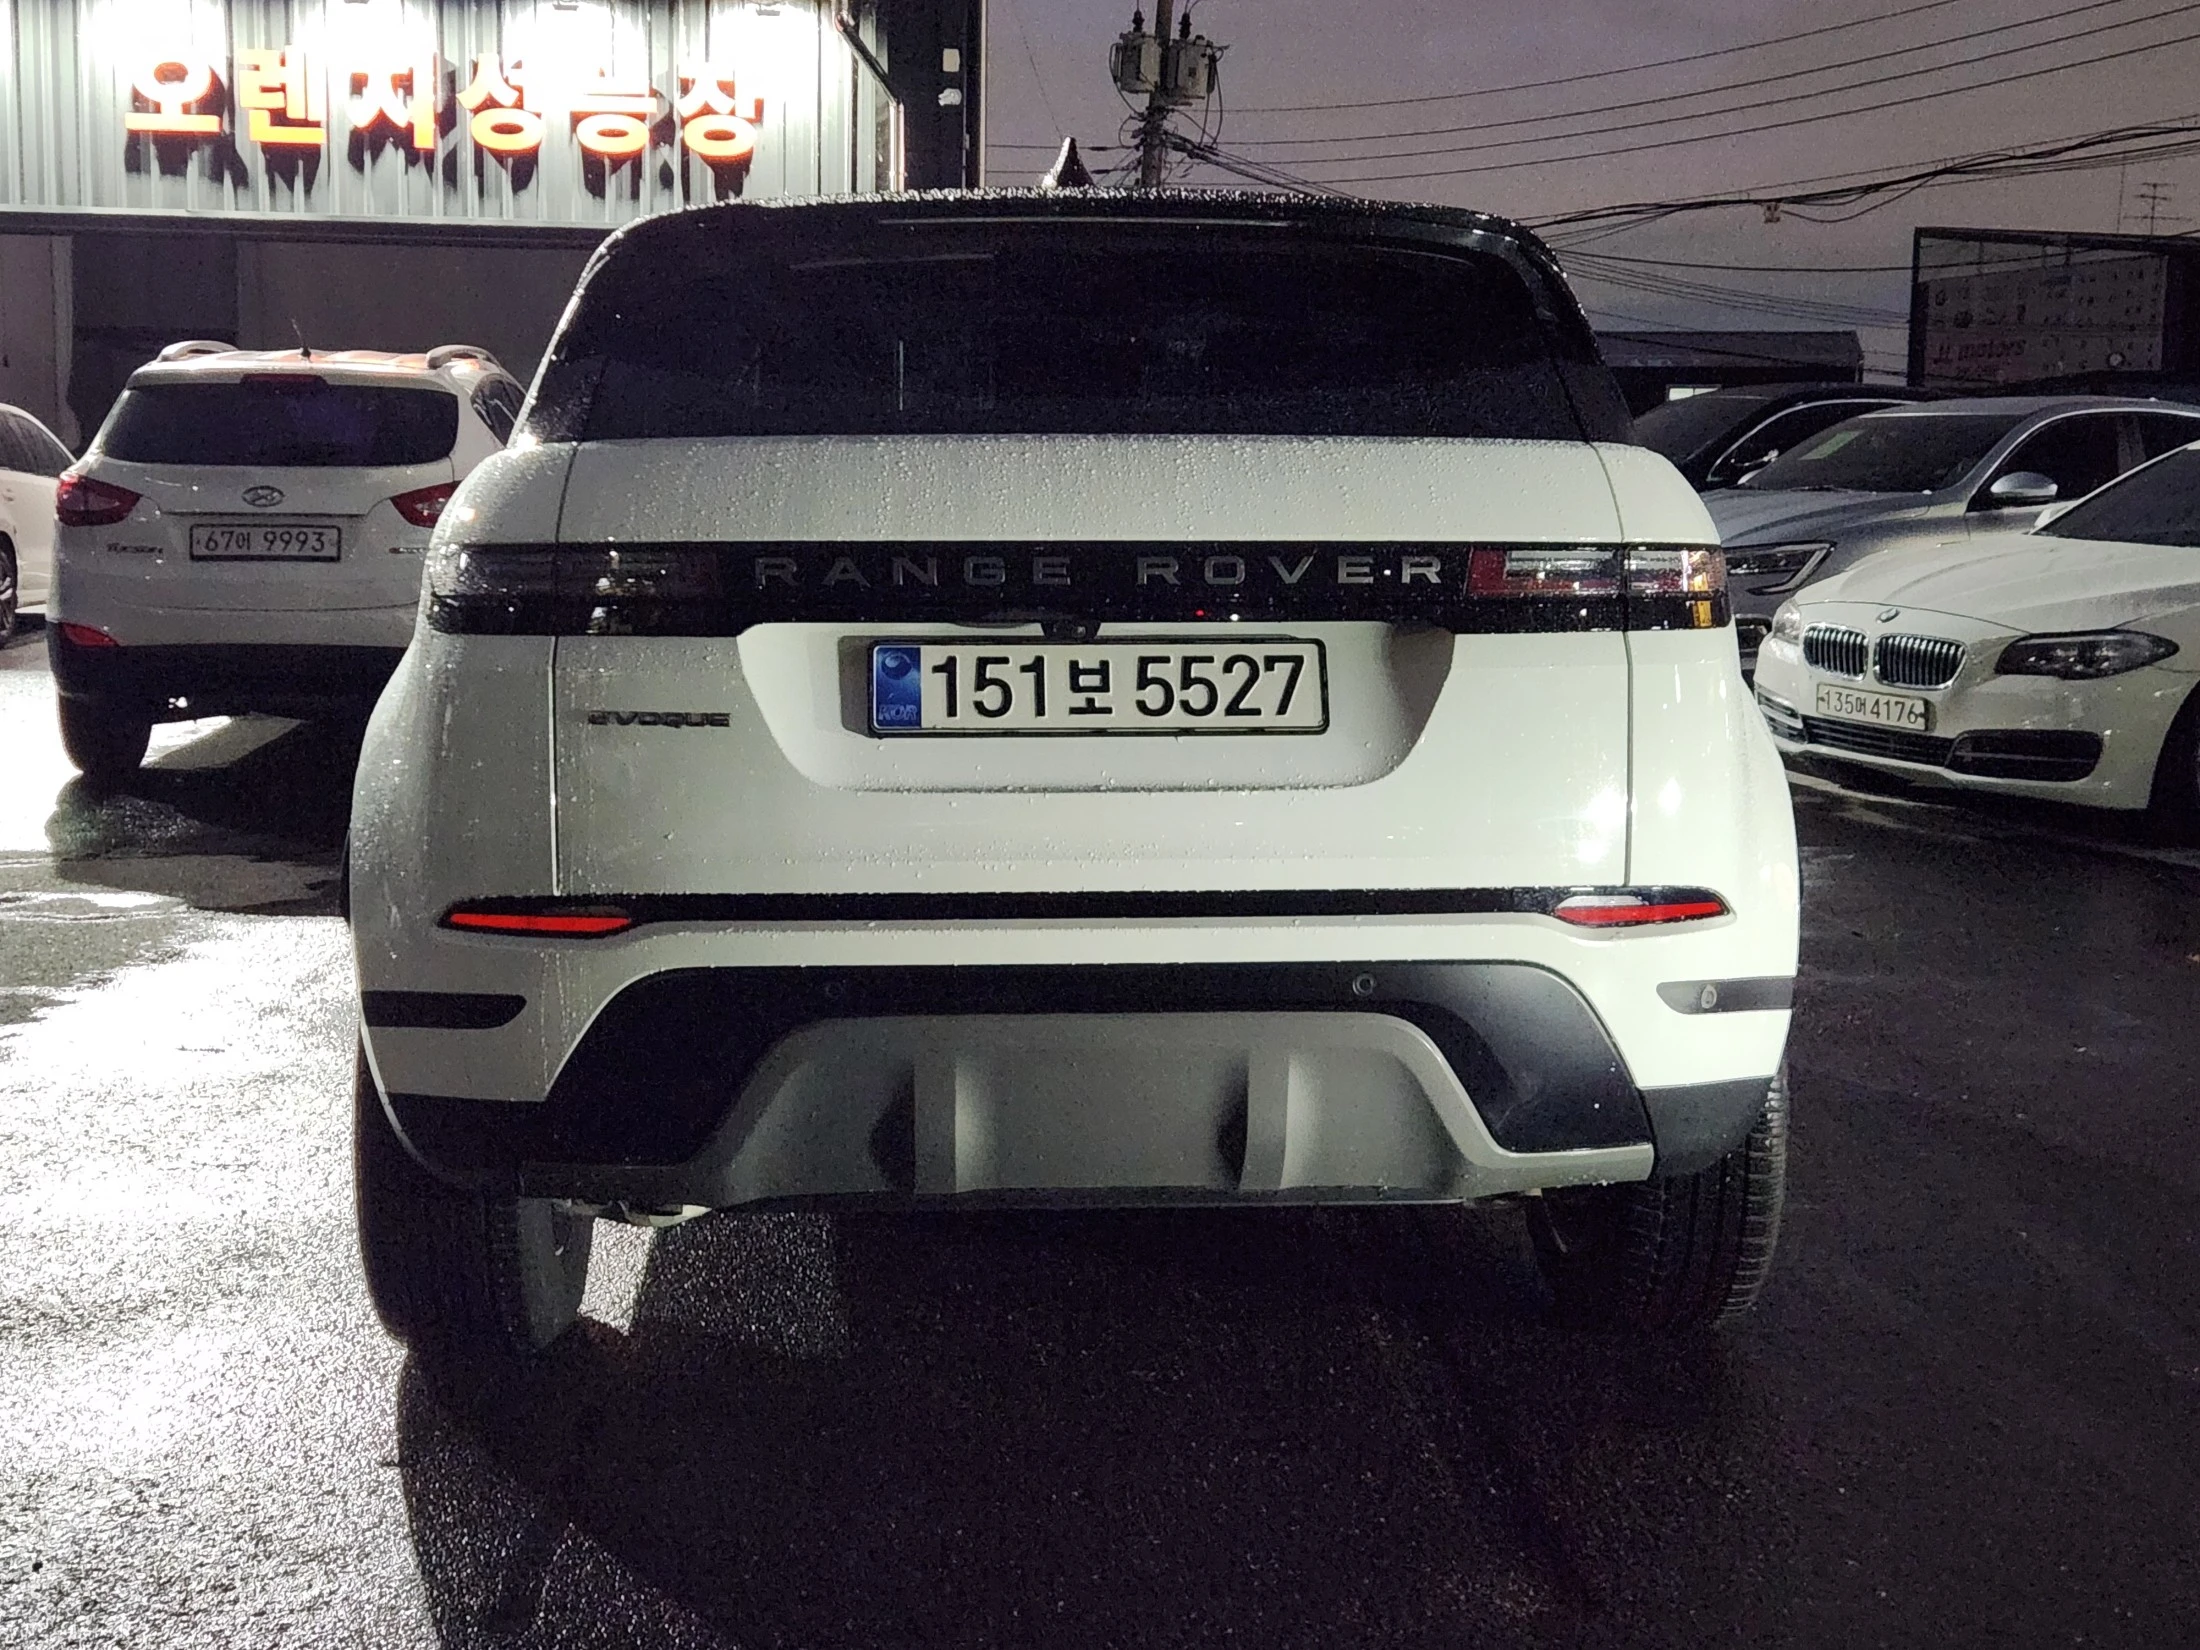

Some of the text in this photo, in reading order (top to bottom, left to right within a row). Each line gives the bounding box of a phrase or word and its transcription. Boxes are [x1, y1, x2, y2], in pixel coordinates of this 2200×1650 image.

[263, 530, 325, 553] 9993
[755, 555, 1442, 587] RANGE ROVER
[931, 654, 1304, 718] 151보 5527
[588, 710, 730, 728] EVOQUE
[878, 704, 917, 721] KOR
[1869, 697, 1919, 725] 4176
